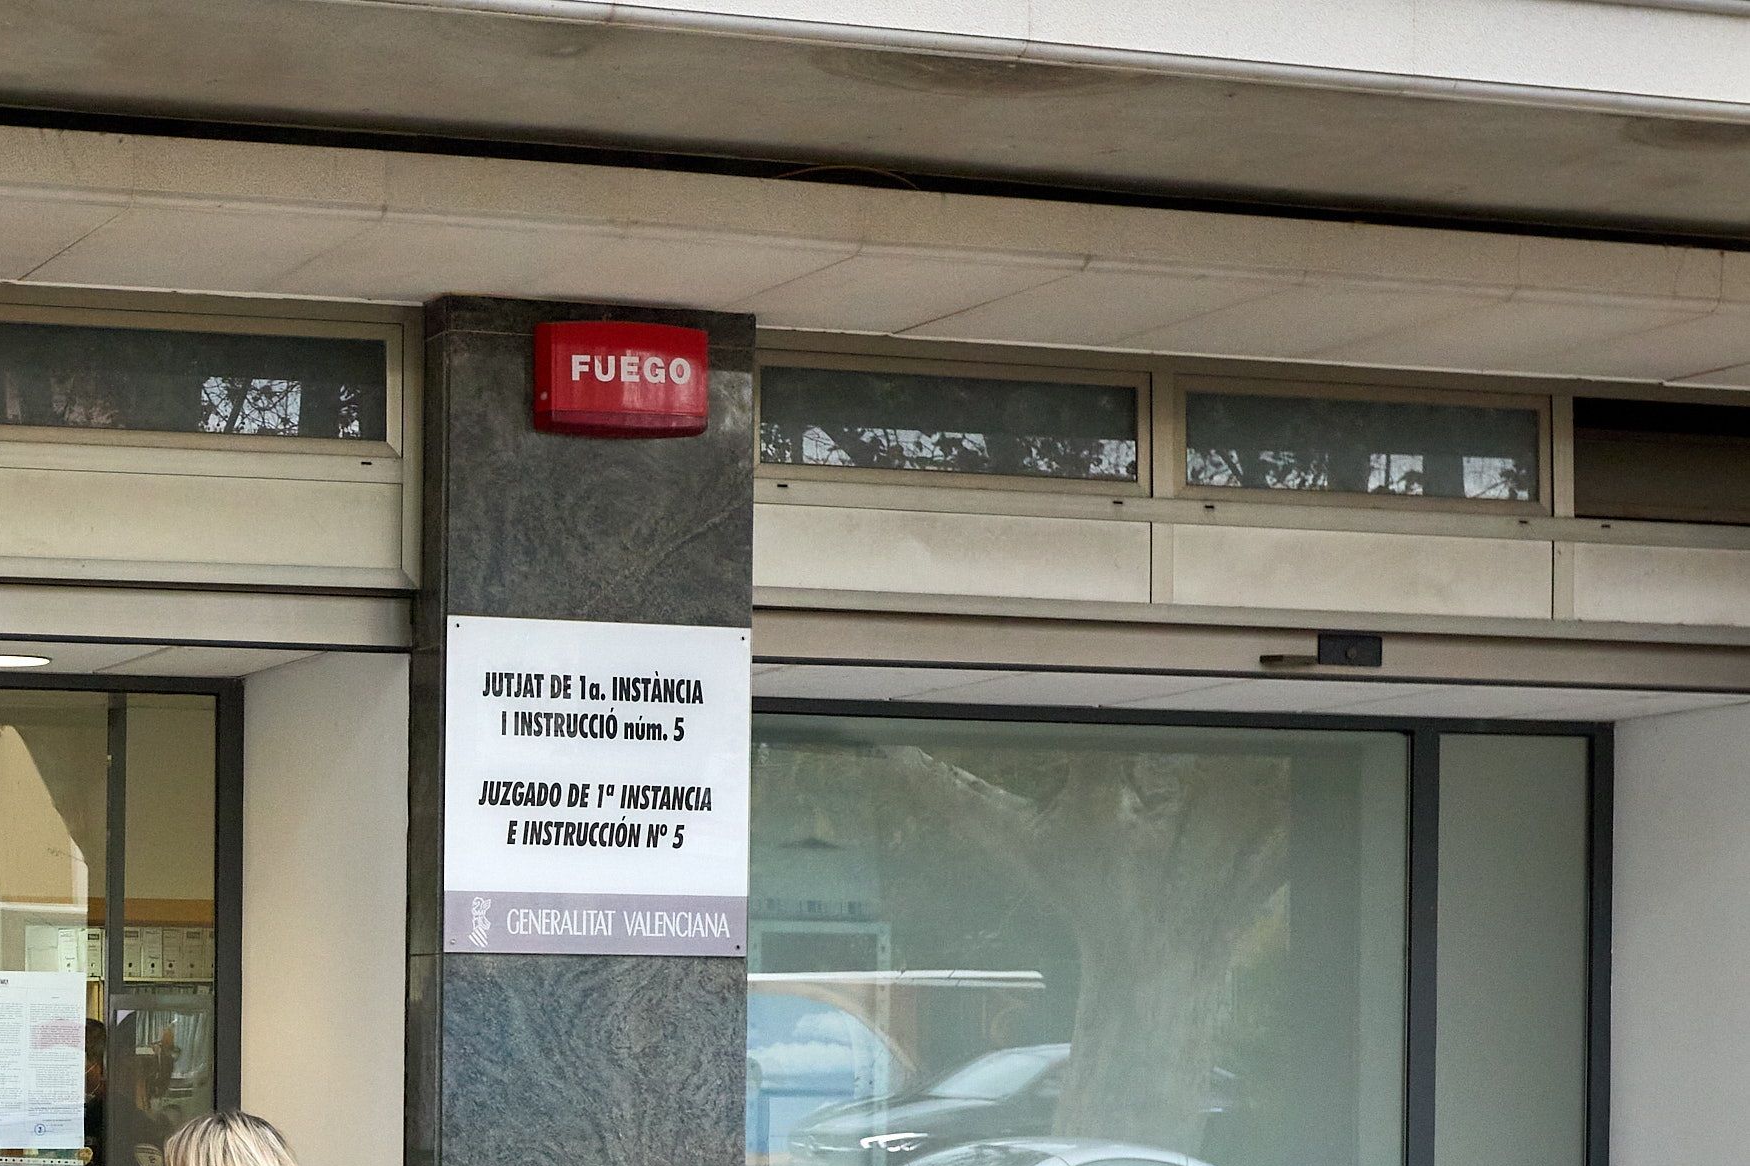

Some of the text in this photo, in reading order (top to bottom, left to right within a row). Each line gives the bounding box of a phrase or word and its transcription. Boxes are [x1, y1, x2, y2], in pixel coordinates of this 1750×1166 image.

[572, 355, 691, 384] FUEGO
[483, 671, 704, 704] JUTJAT DE 1a. INSTÀNCIA
[502, 708, 685, 741] I INSTRUCCIÓ núm. 5
[478, 781, 712, 811] JUZGADO DE 1ª INSTANCIA
[507, 816, 685, 849] E INSTRUCCIÓN Nº 5
[507, 909, 730, 938] GENERALITAT VALENCIANA
